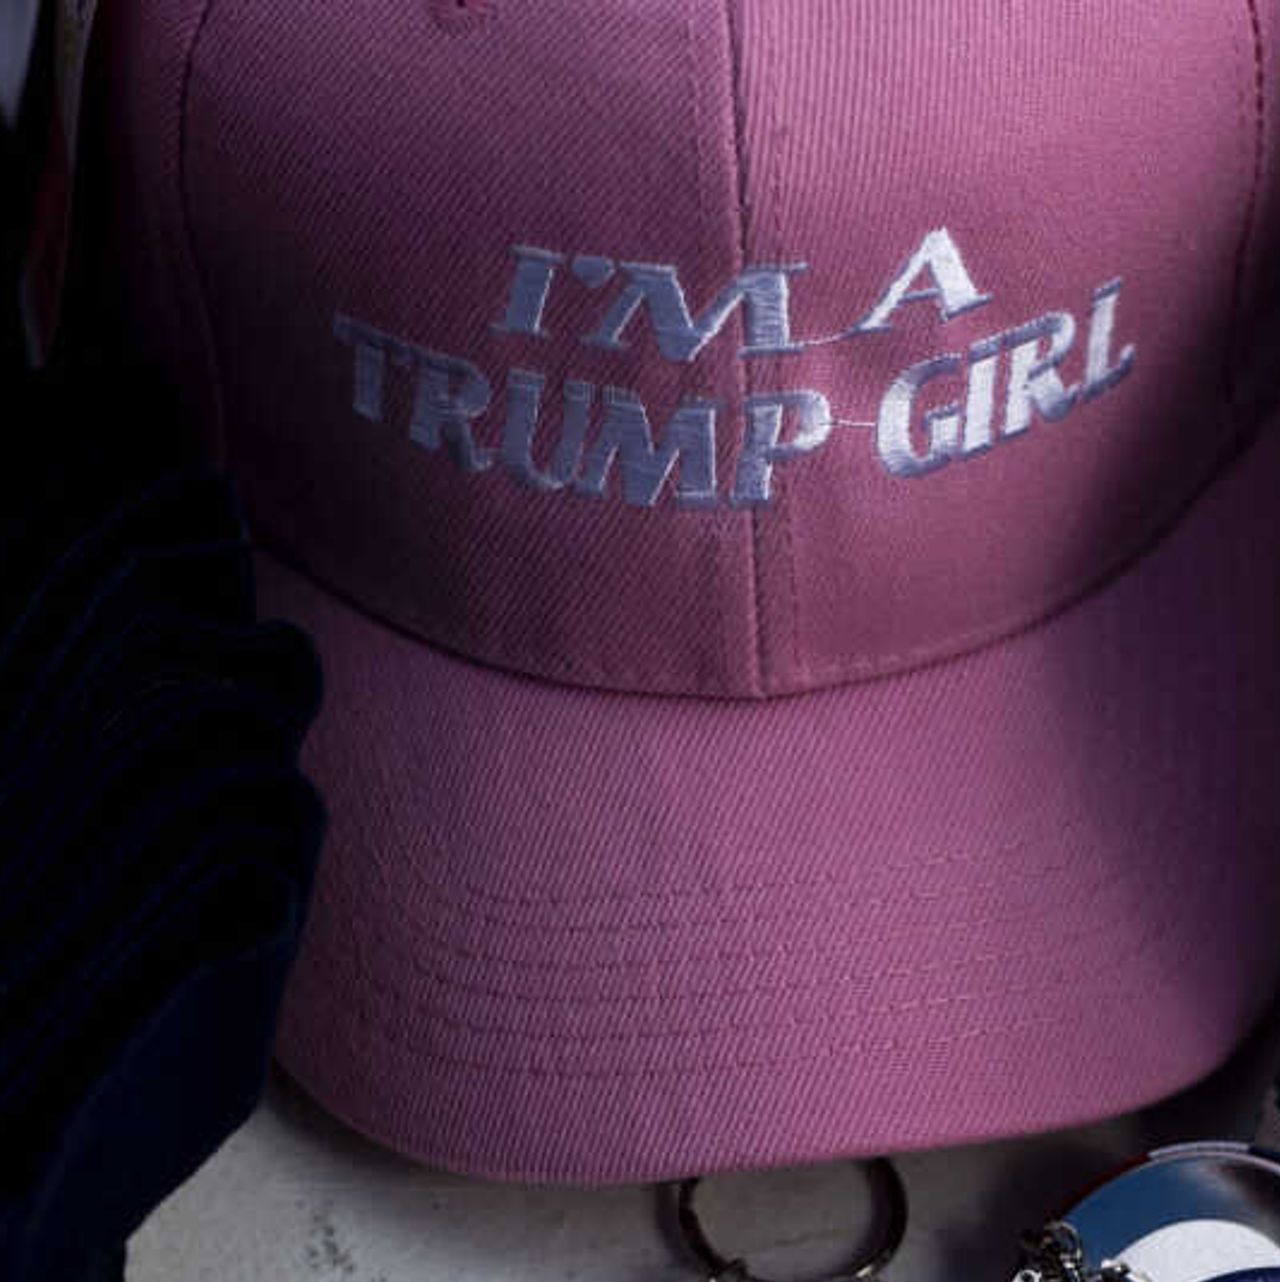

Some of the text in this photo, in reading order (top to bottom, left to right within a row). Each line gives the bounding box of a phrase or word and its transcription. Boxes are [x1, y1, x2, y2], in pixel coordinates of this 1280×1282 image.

[488, 226, 994, 362] I'M A
[332, 275, 1137, 510] TRUMP GIRL
